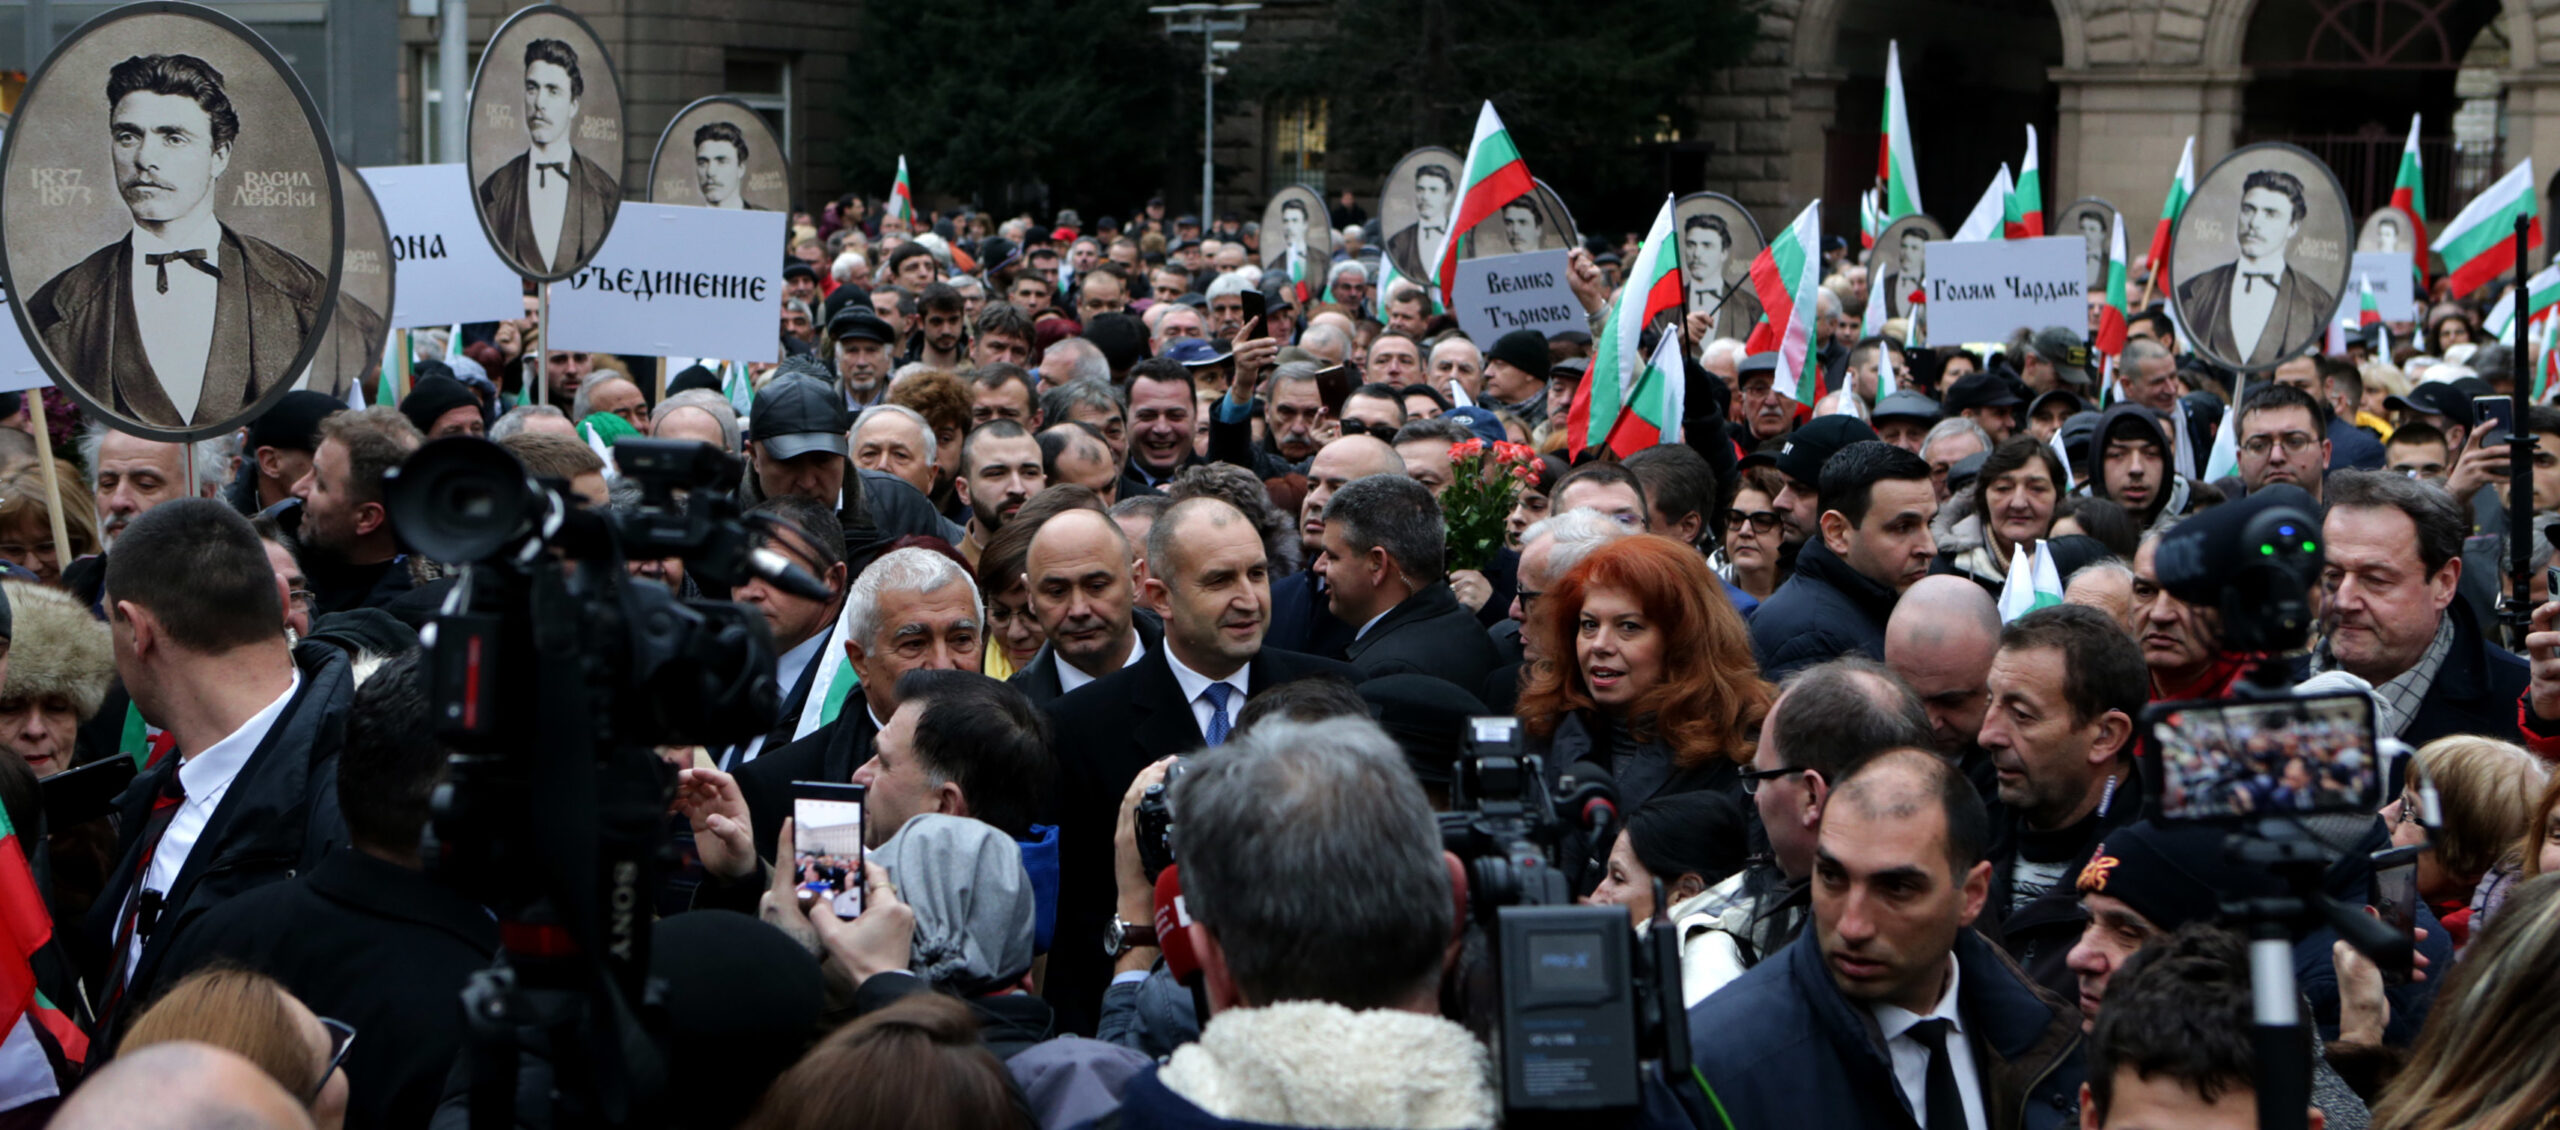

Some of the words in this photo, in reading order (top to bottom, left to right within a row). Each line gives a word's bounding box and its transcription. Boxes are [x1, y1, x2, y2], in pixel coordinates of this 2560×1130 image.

[31, 168, 83, 190] 1837
[41, 185, 92, 207] 1873
[1487, 271, 1554, 294] Велико
[1934, 279, 1996, 301] Голям
[2005, 276, 2081, 306] Чардак
[1484, 304, 1571, 331] Търново
[610, 861, 638, 961] SONY
